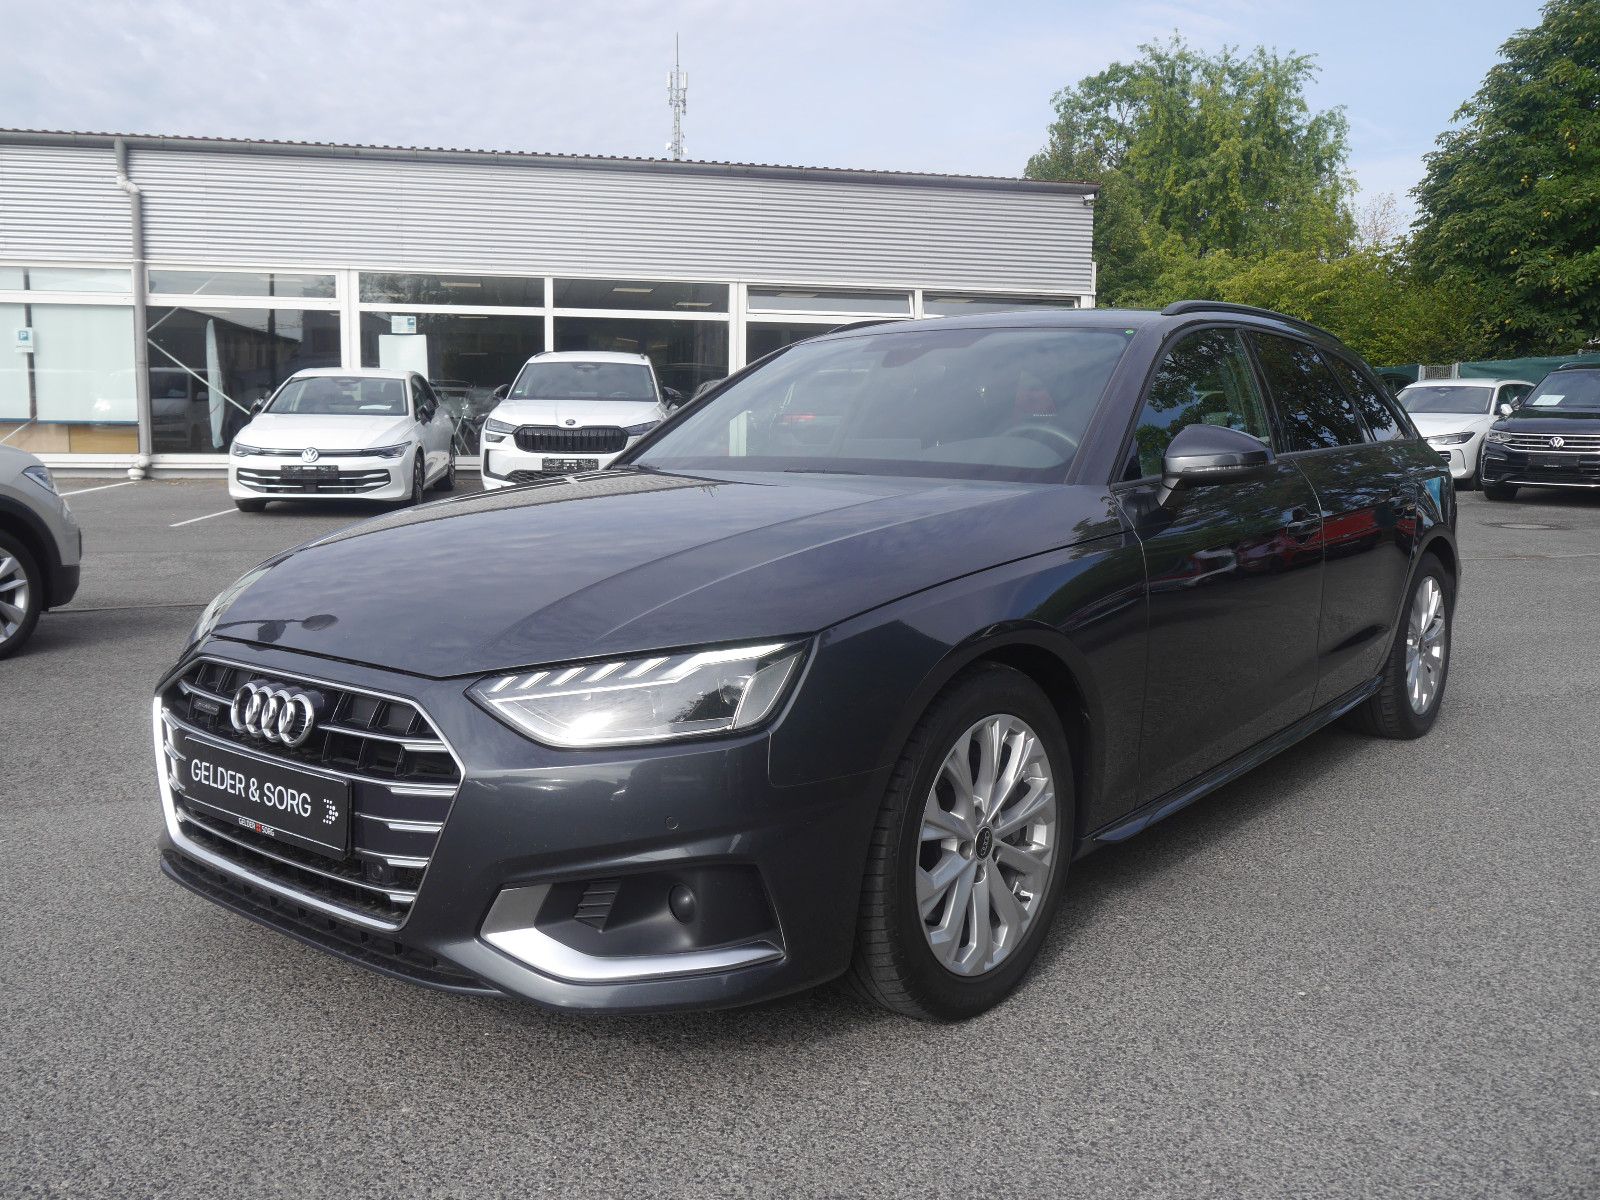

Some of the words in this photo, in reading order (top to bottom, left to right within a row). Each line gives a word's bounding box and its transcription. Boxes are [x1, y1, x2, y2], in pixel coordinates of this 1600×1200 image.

[191, 759, 245, 798] GELDER
[249, 778, 260, 802] &
[264, 783, 312, 817] SORG
[239, 817, 256, 829] GELDER
